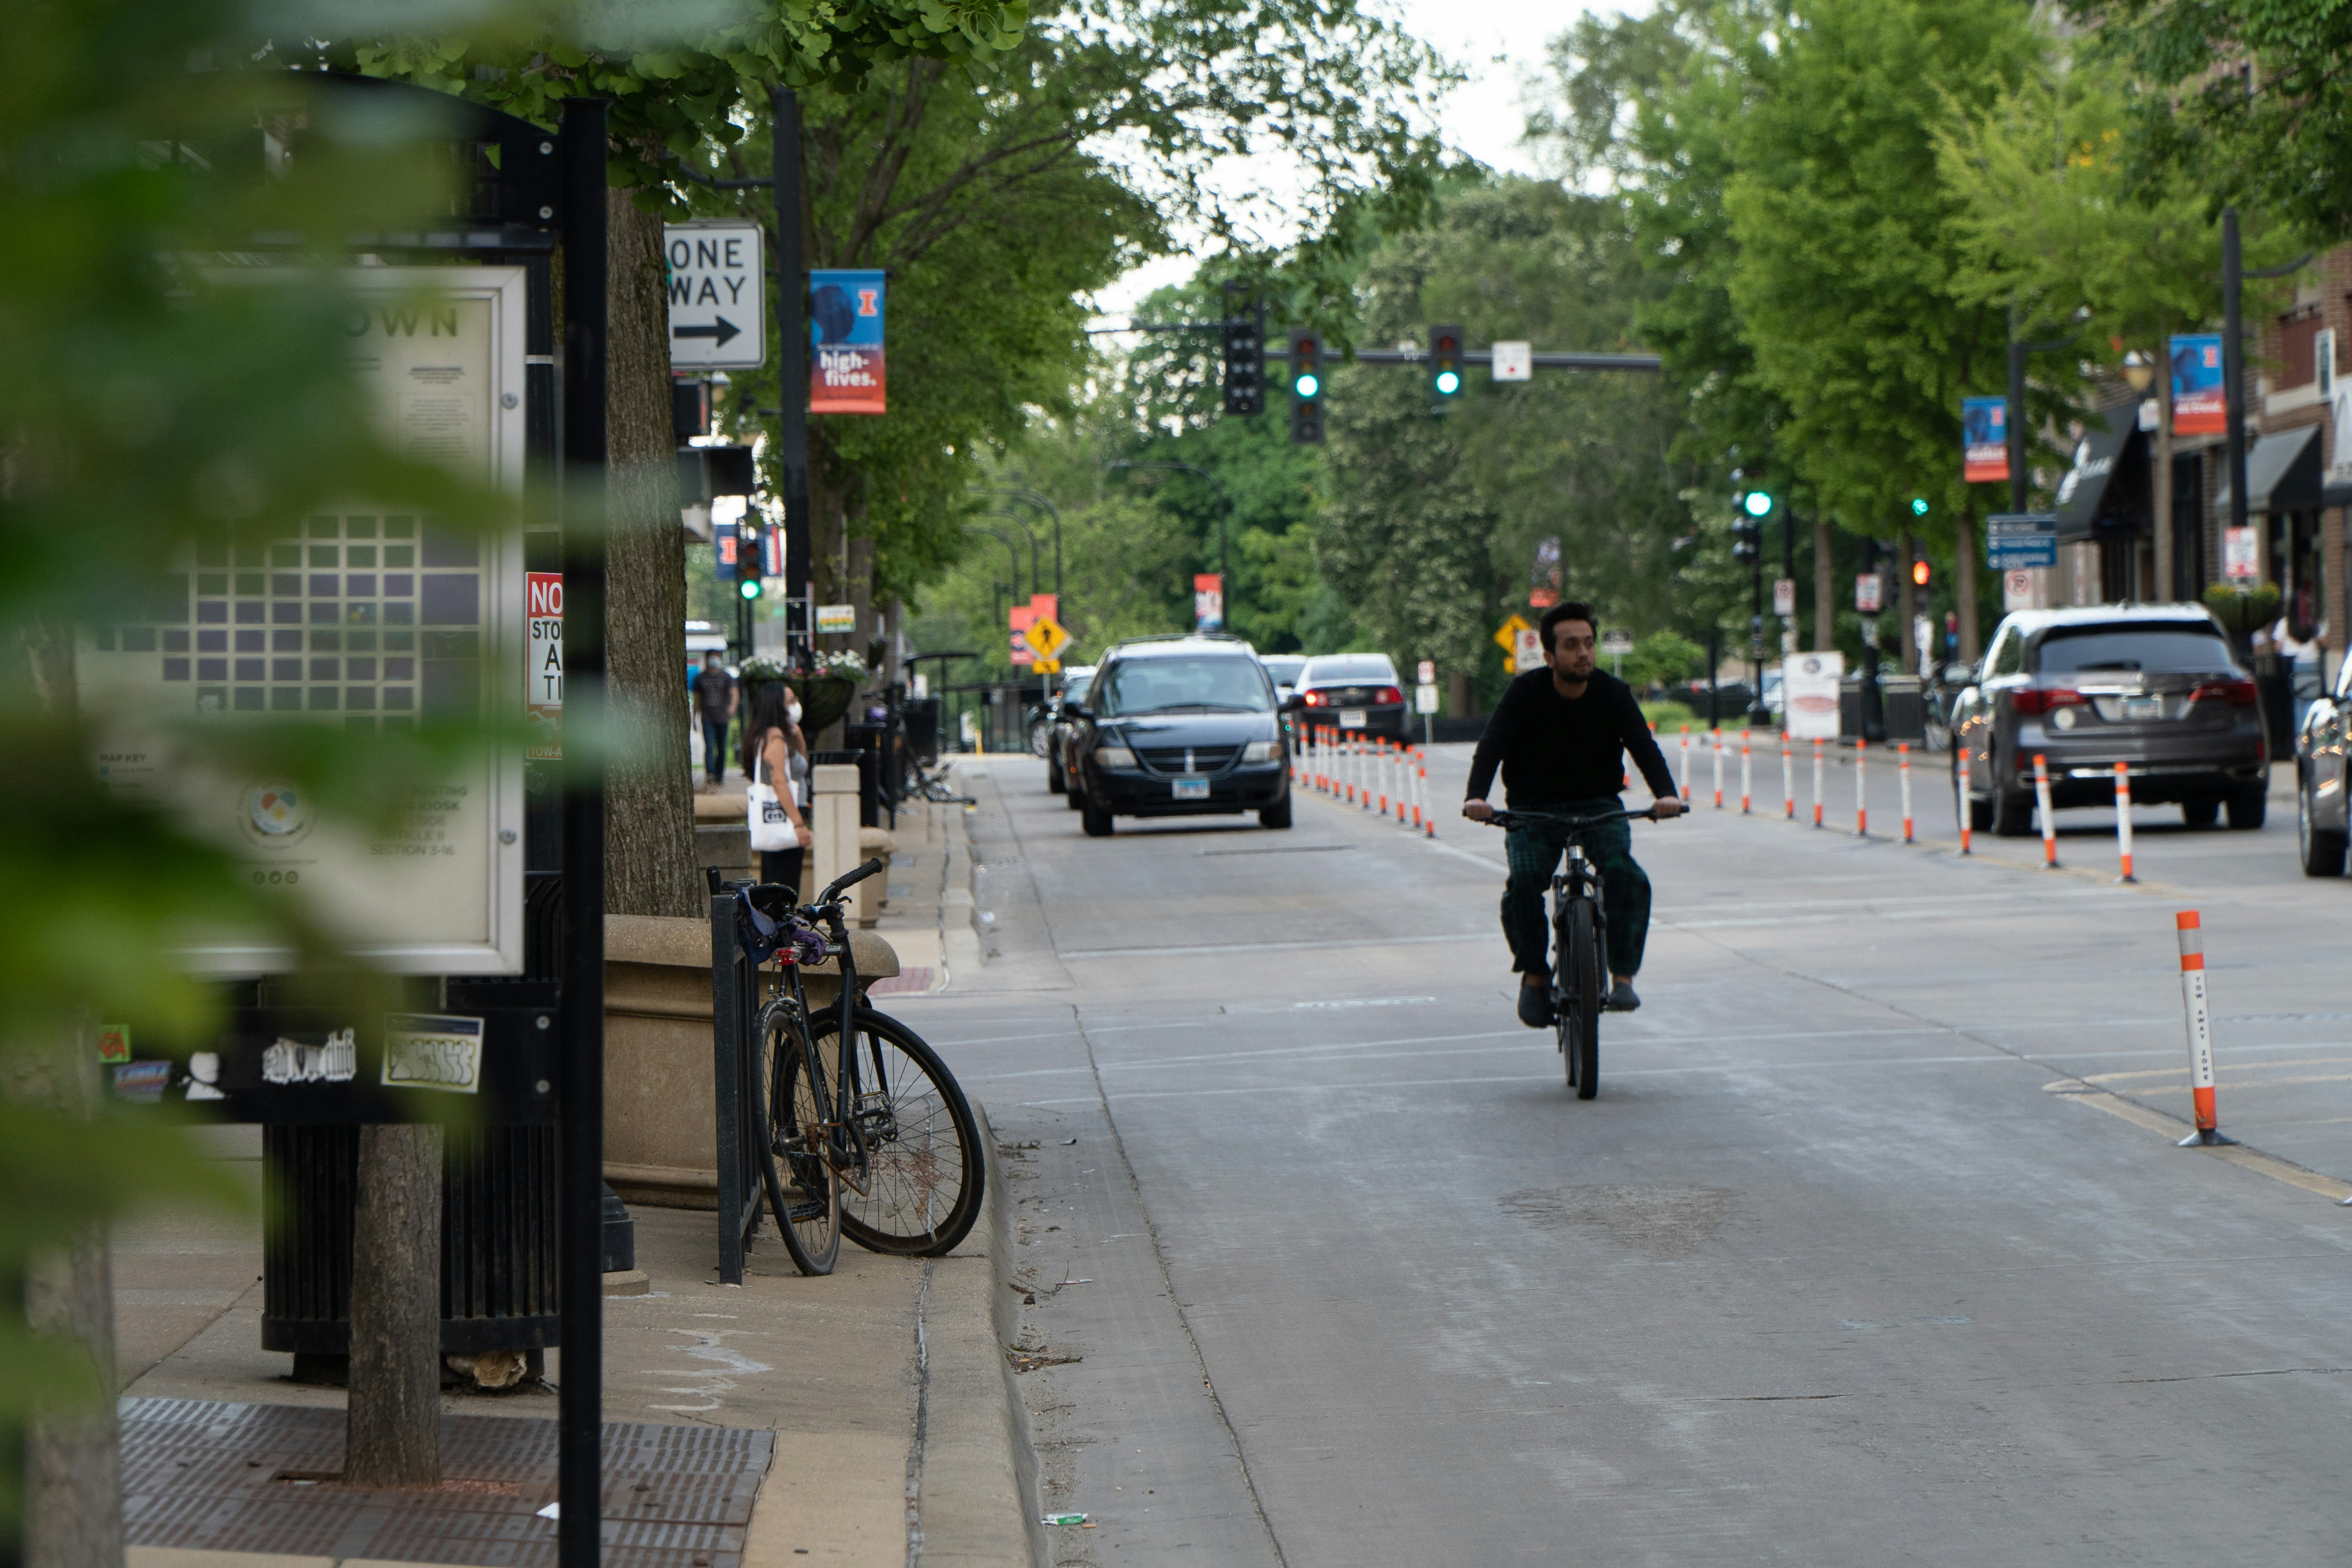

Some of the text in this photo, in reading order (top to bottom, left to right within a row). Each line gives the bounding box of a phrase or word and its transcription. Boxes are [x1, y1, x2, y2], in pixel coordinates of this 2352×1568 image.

[671, 239, 743, 269] ONE
[669, 276, 746, 306] WAY
[820, 350, 870, 373] high-
[824, 370, 878, 387] fives.
[532, 581, 563, 614] NO
[532, 620, 563, 640] STO
[100, 753, 147, 762] MAP KEY
[419, 800, 461, 811] KIOSK
[370, 844, 426, 855] SECTION
[2197, 1009, 2205, 1040] AWAY
